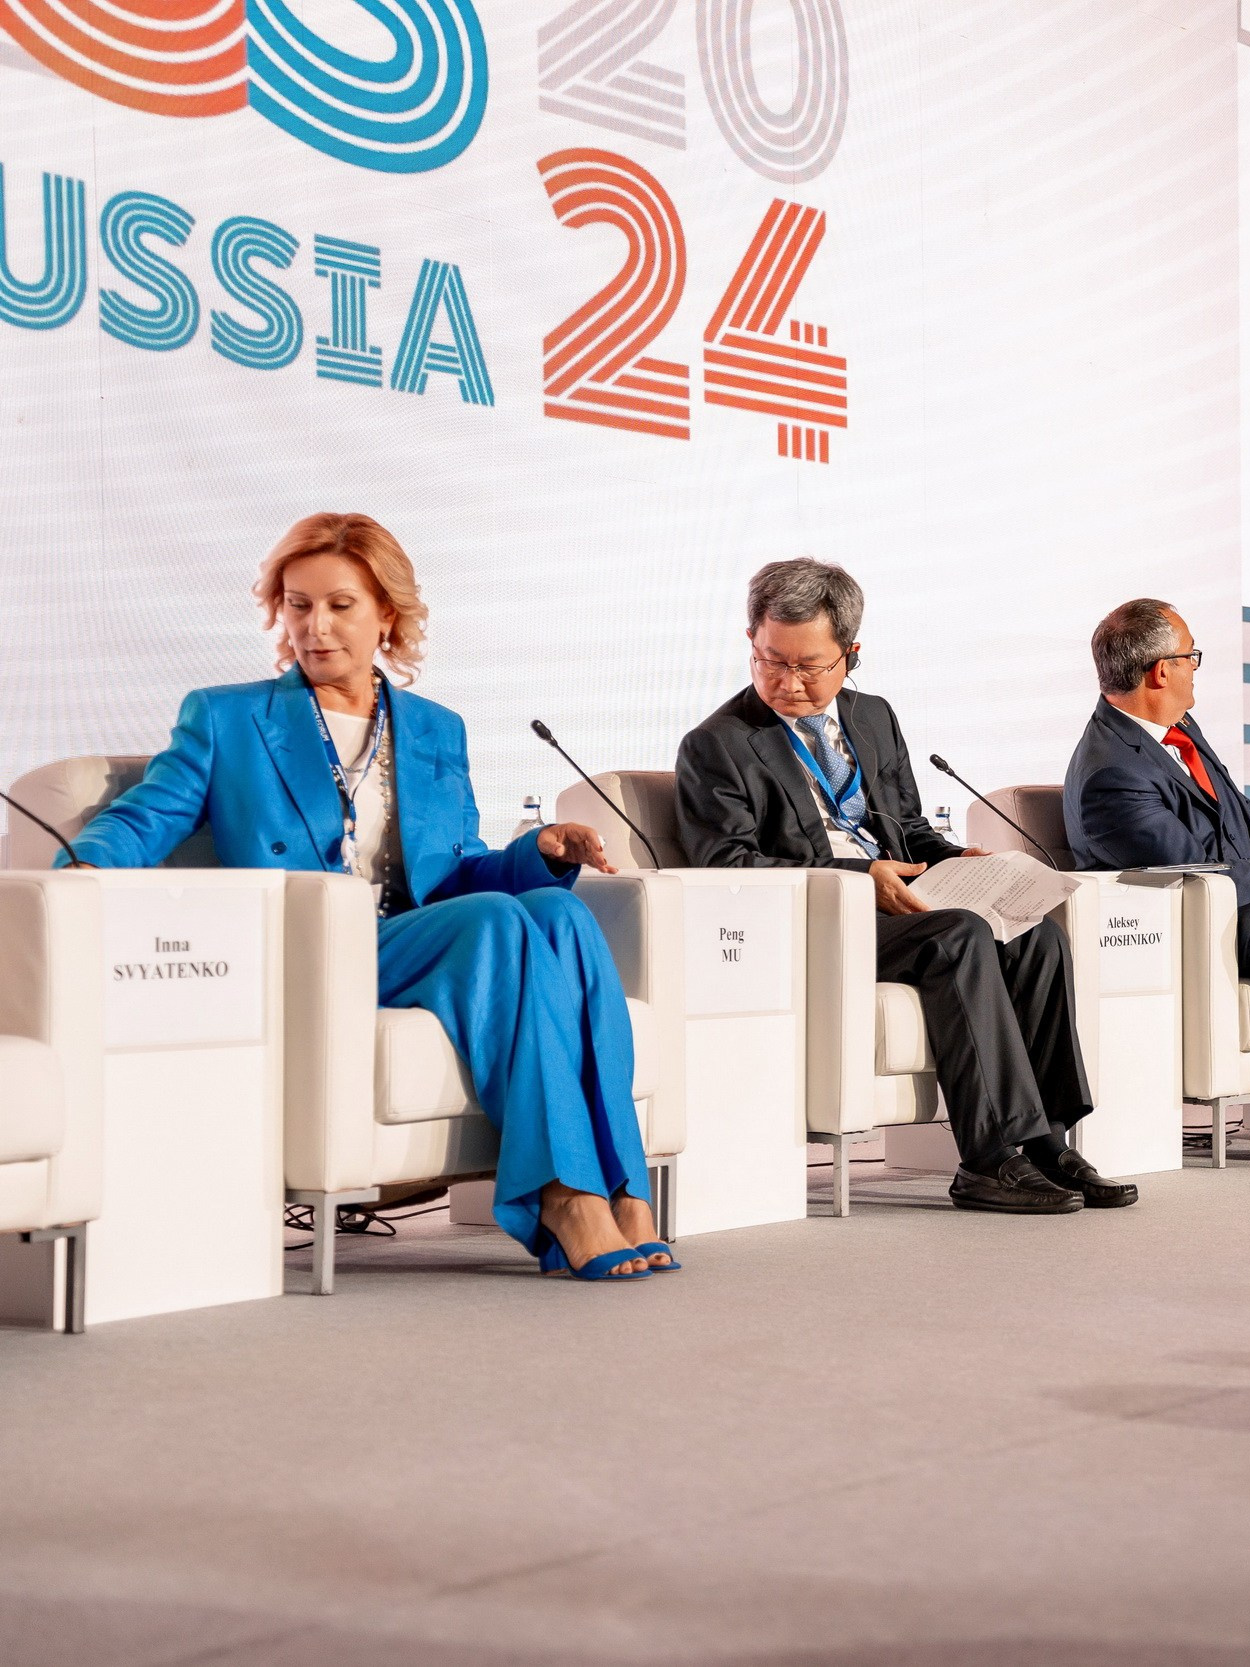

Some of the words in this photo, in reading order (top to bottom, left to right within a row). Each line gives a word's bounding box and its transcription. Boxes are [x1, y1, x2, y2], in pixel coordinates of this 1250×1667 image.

[536, 147, 848, 464] 24
[1106, 917, 1139, 930] Aleksey
[719, 927, 745, 944] Peng
[154, 937, 191, 953] Inna
[721, 948, 742, 962] MU
[112, 961, 229, 982] SVYATENKO
